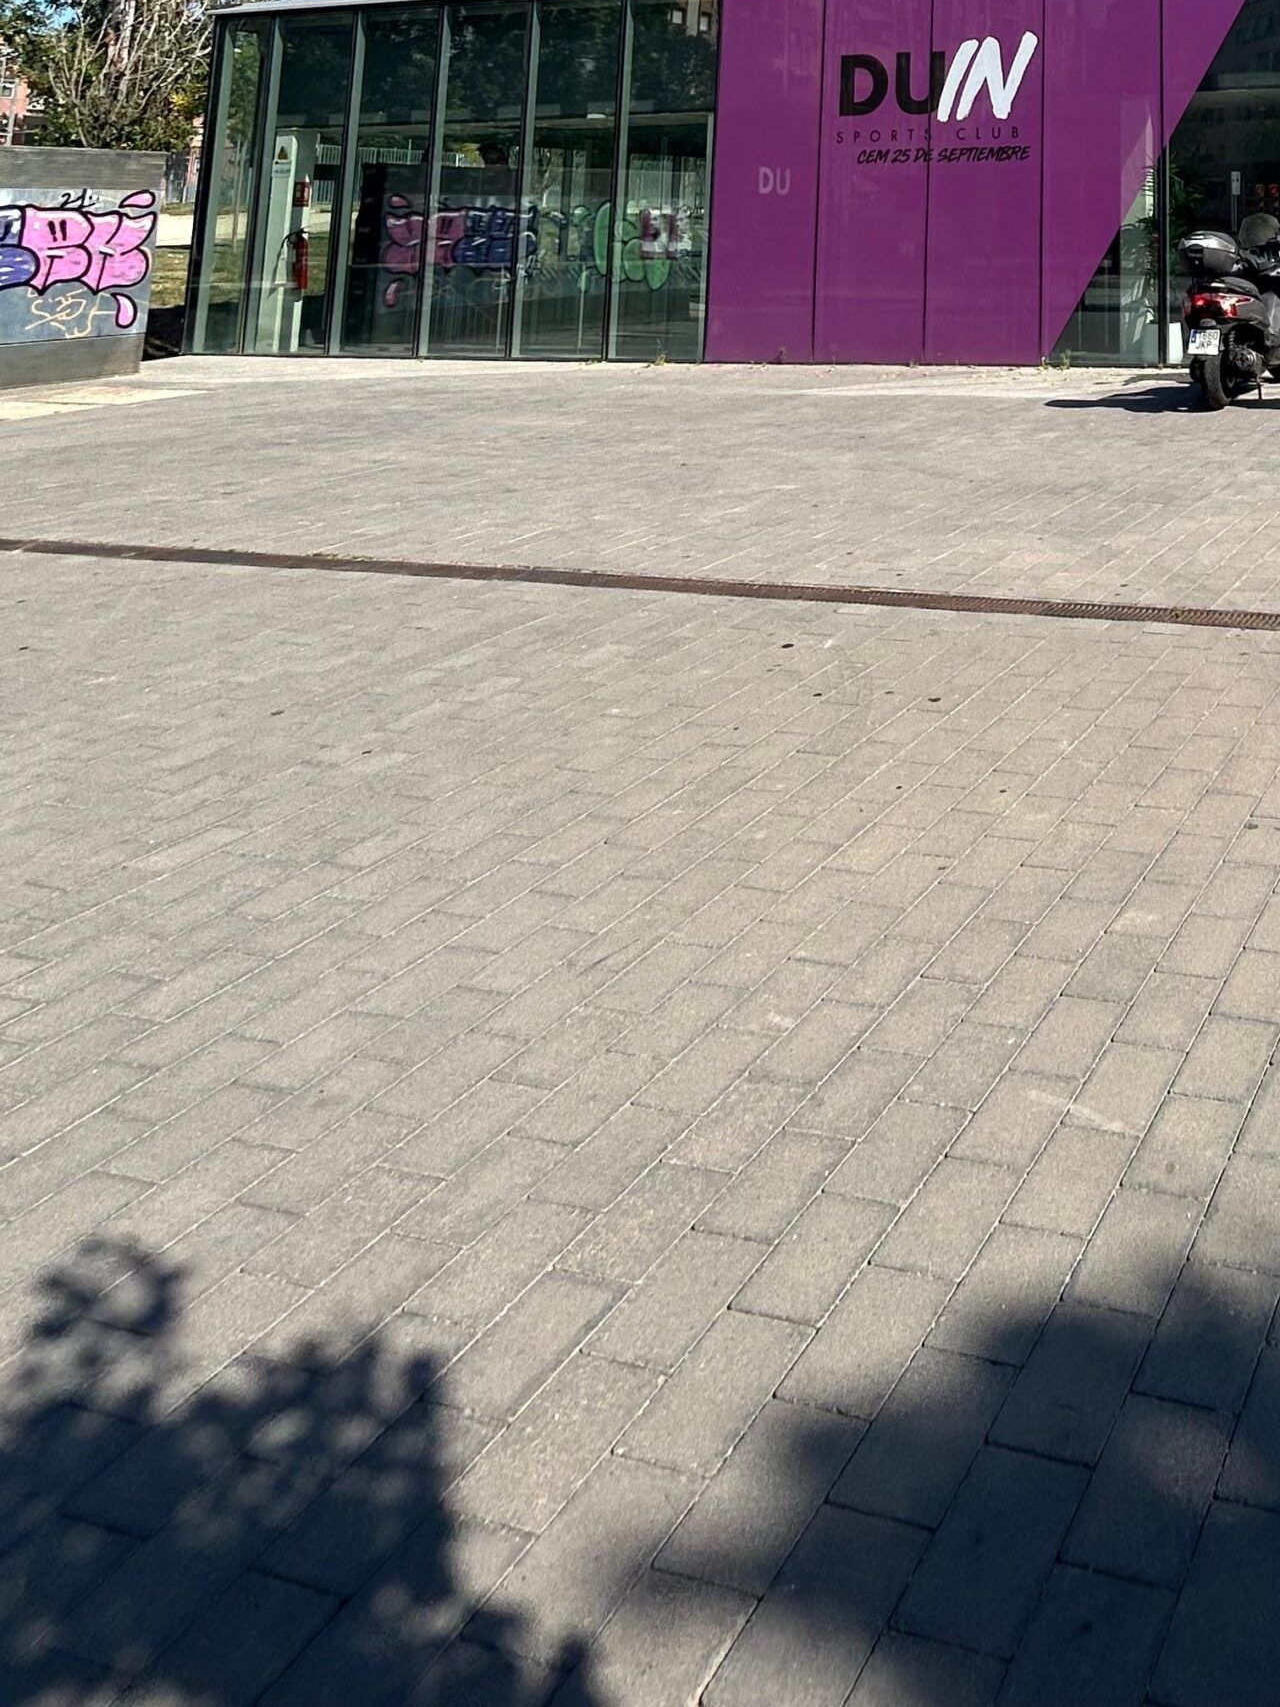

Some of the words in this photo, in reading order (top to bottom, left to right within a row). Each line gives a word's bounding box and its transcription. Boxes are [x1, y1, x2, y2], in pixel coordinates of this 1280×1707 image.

[836, 127, 932, 144] SPORTS
[956, 125, 1020, 140] CLUB
[857, 149, 890, 164] CEM
[891, 148, 911, 163] 25
[913, 148, 934, 163] DE
[938, 145, 1032, 163] SEPTIEMBRE
[759, 166, 790, 195] DU
[1196, 340, 1212, 349] JKP
